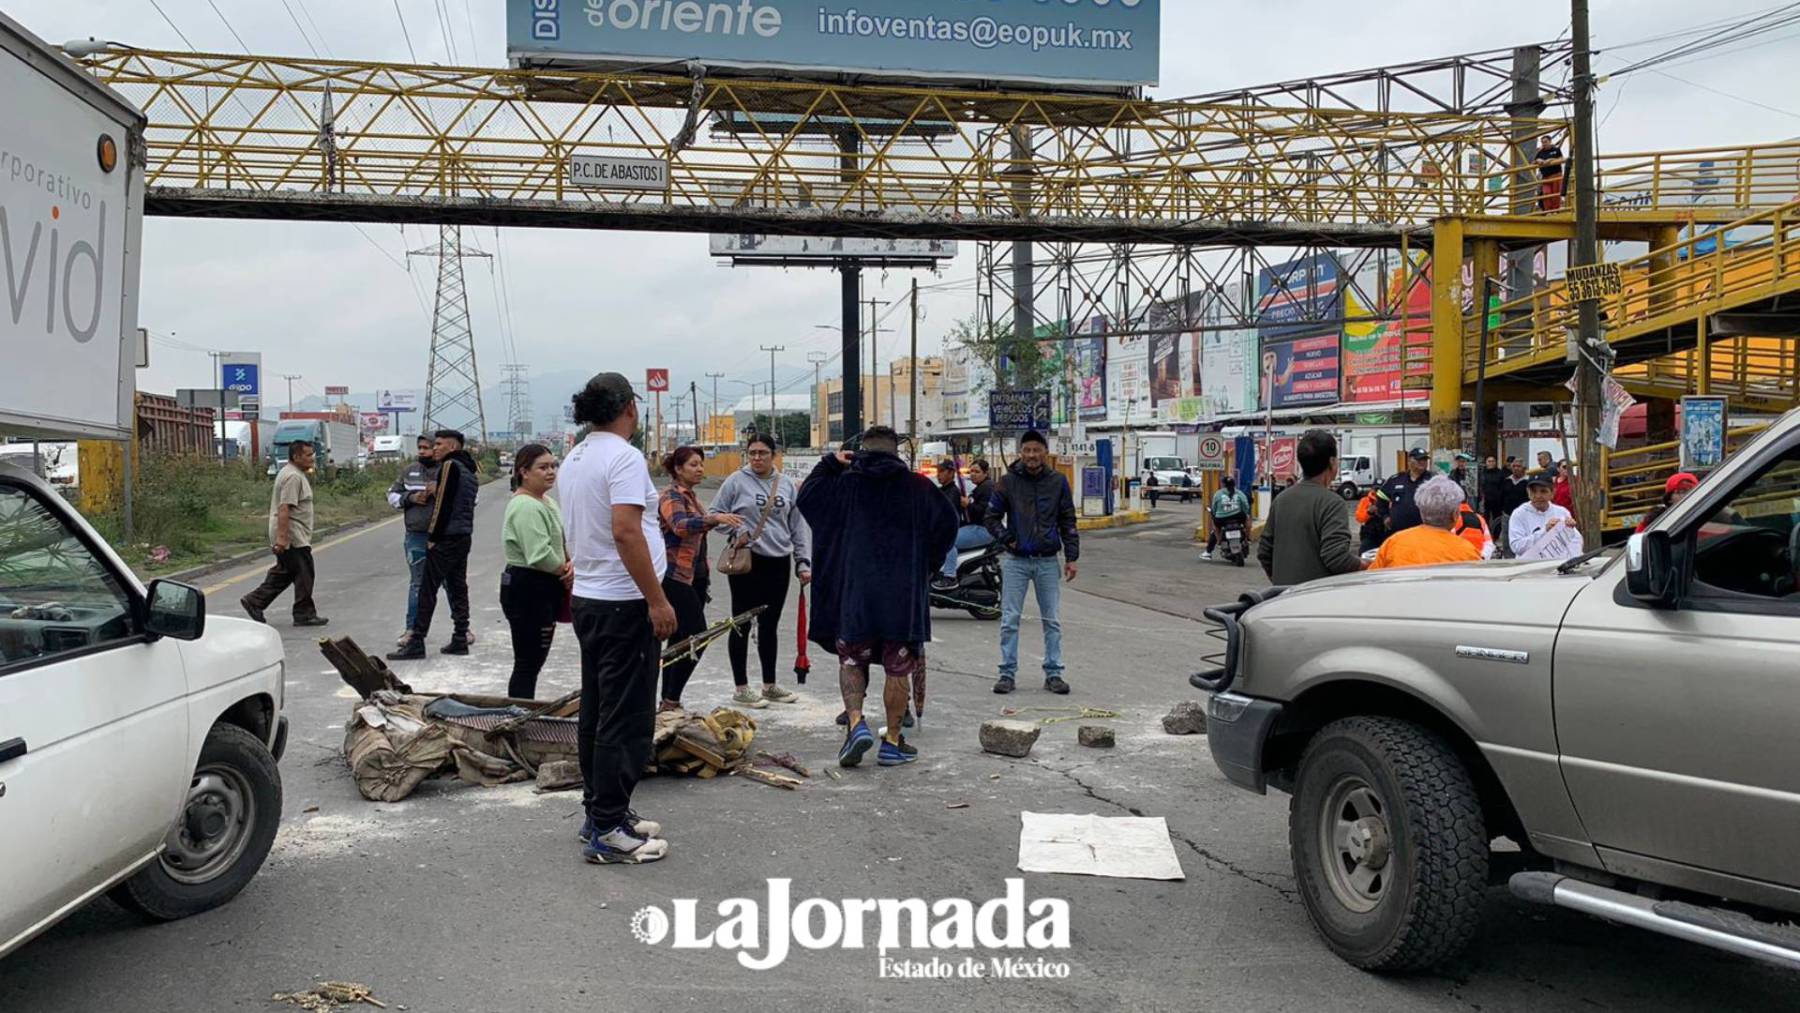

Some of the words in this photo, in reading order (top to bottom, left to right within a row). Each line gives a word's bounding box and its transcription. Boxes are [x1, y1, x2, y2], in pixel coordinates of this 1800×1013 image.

[817, 8, 1133, 51] infoventas@eopuk.mx
[594, 163, 609, 179] DE
[610, 164, 658, 181] ABASTOS
[1566, 262, 1620, 281] MUDANZAS
[1206, 442, 1216, 452] 10
